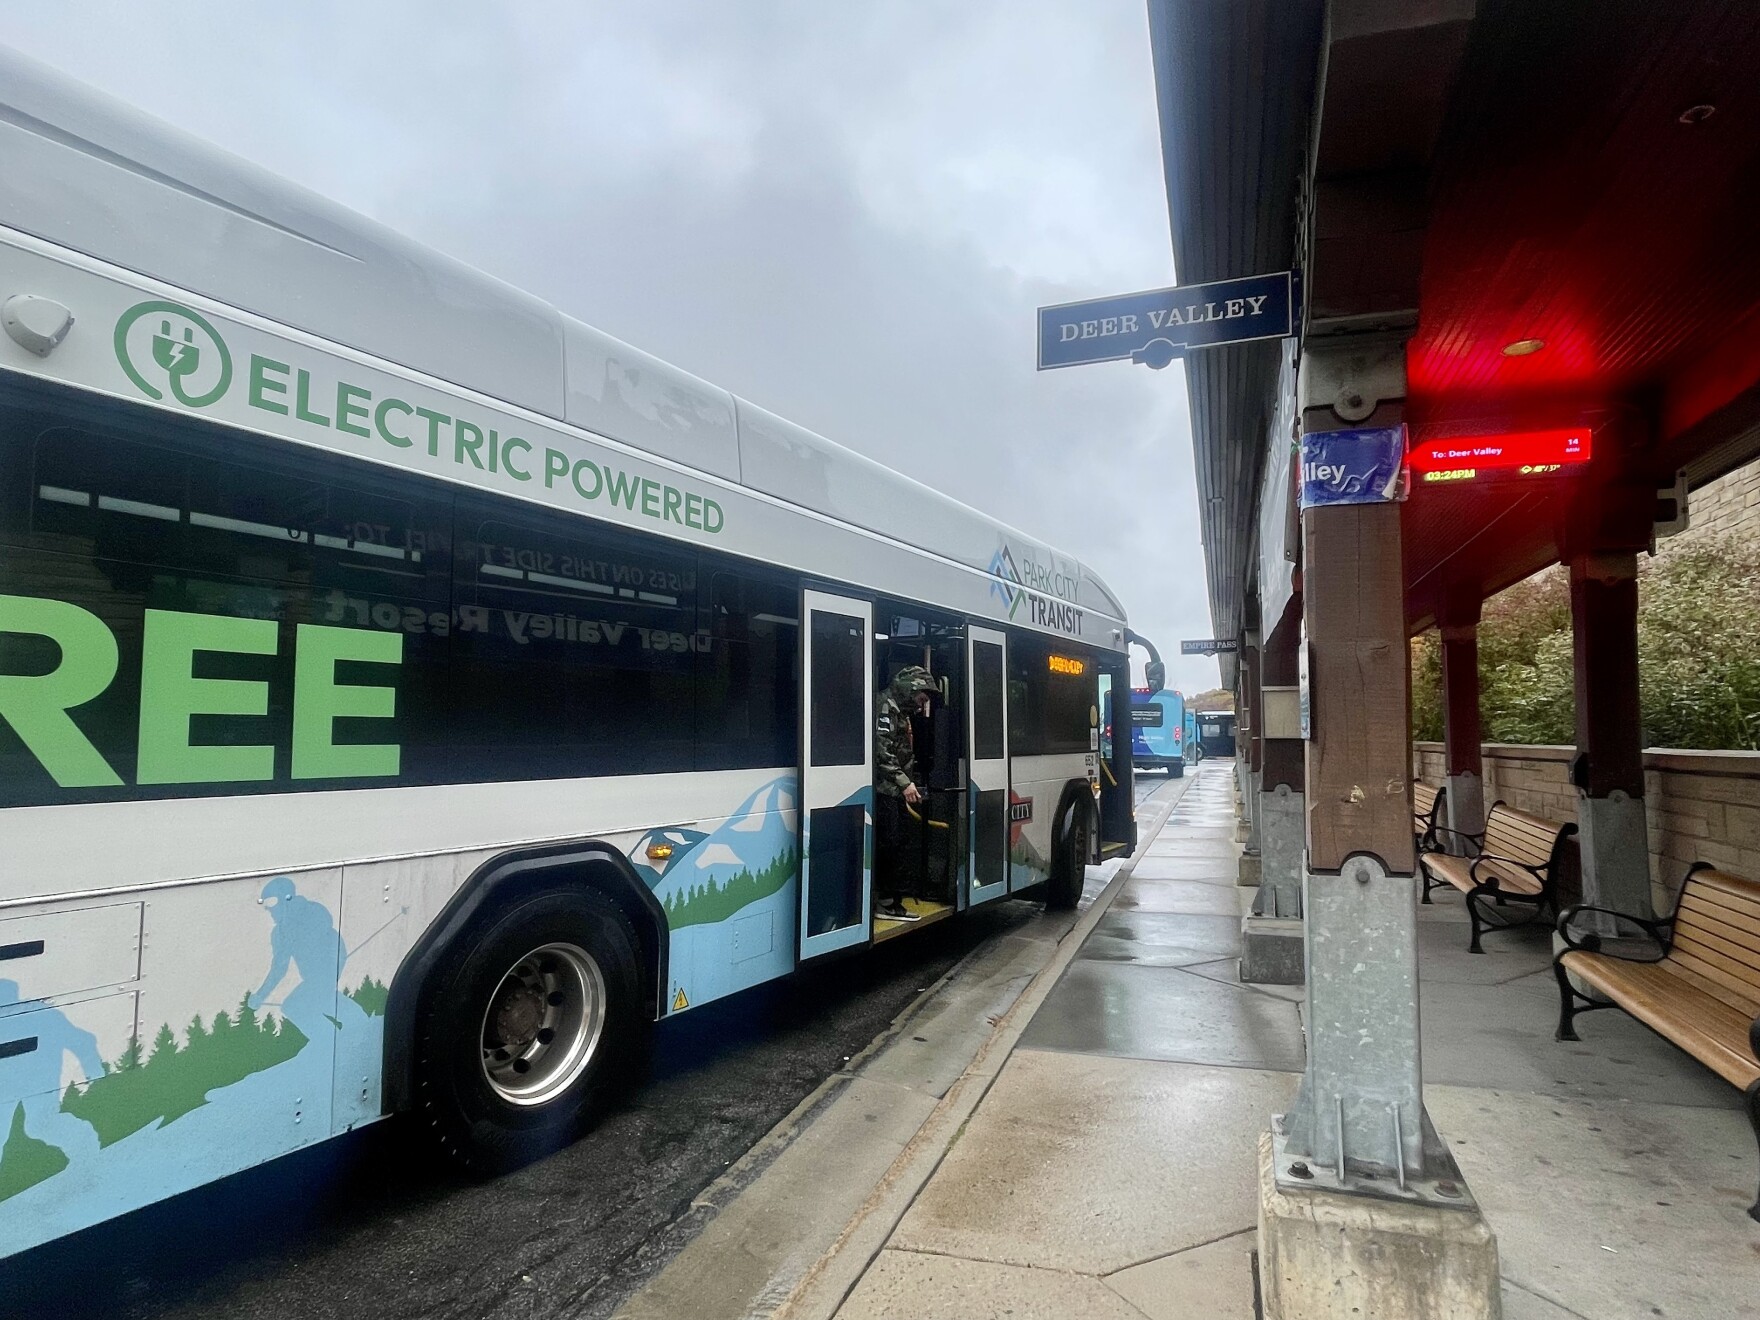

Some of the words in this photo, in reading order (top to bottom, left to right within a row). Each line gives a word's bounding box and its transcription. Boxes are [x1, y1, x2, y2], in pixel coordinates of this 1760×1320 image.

[1059, 314, 1139, 343] DEER
[1147, 295, 1268, 329] VALLEY
[248, 353, 533, 482] ELECTRIC
[544, 447, 725, 534] POWERED
[1567, 438, 1579, 446] 14
[1431, 450, 1447, 459] To:
[1449, 449, 1470, 458] Deer
[1473, 447, 1503, 456] Valley
[1302, 462, 1346, 484] lley
[1425, 468, 1476, 482] 03:24PM
[1023, 558, 1053, 594] PARK
[1055, 573, 1079, 602] CITY
[1028, 594, 1083, 635] TRANSIT
[1183, 641, 1215, 650] EMPIRE
[1216, 640, 1237, 649] PASS
[1011, 802, 1031, 820] CITY
